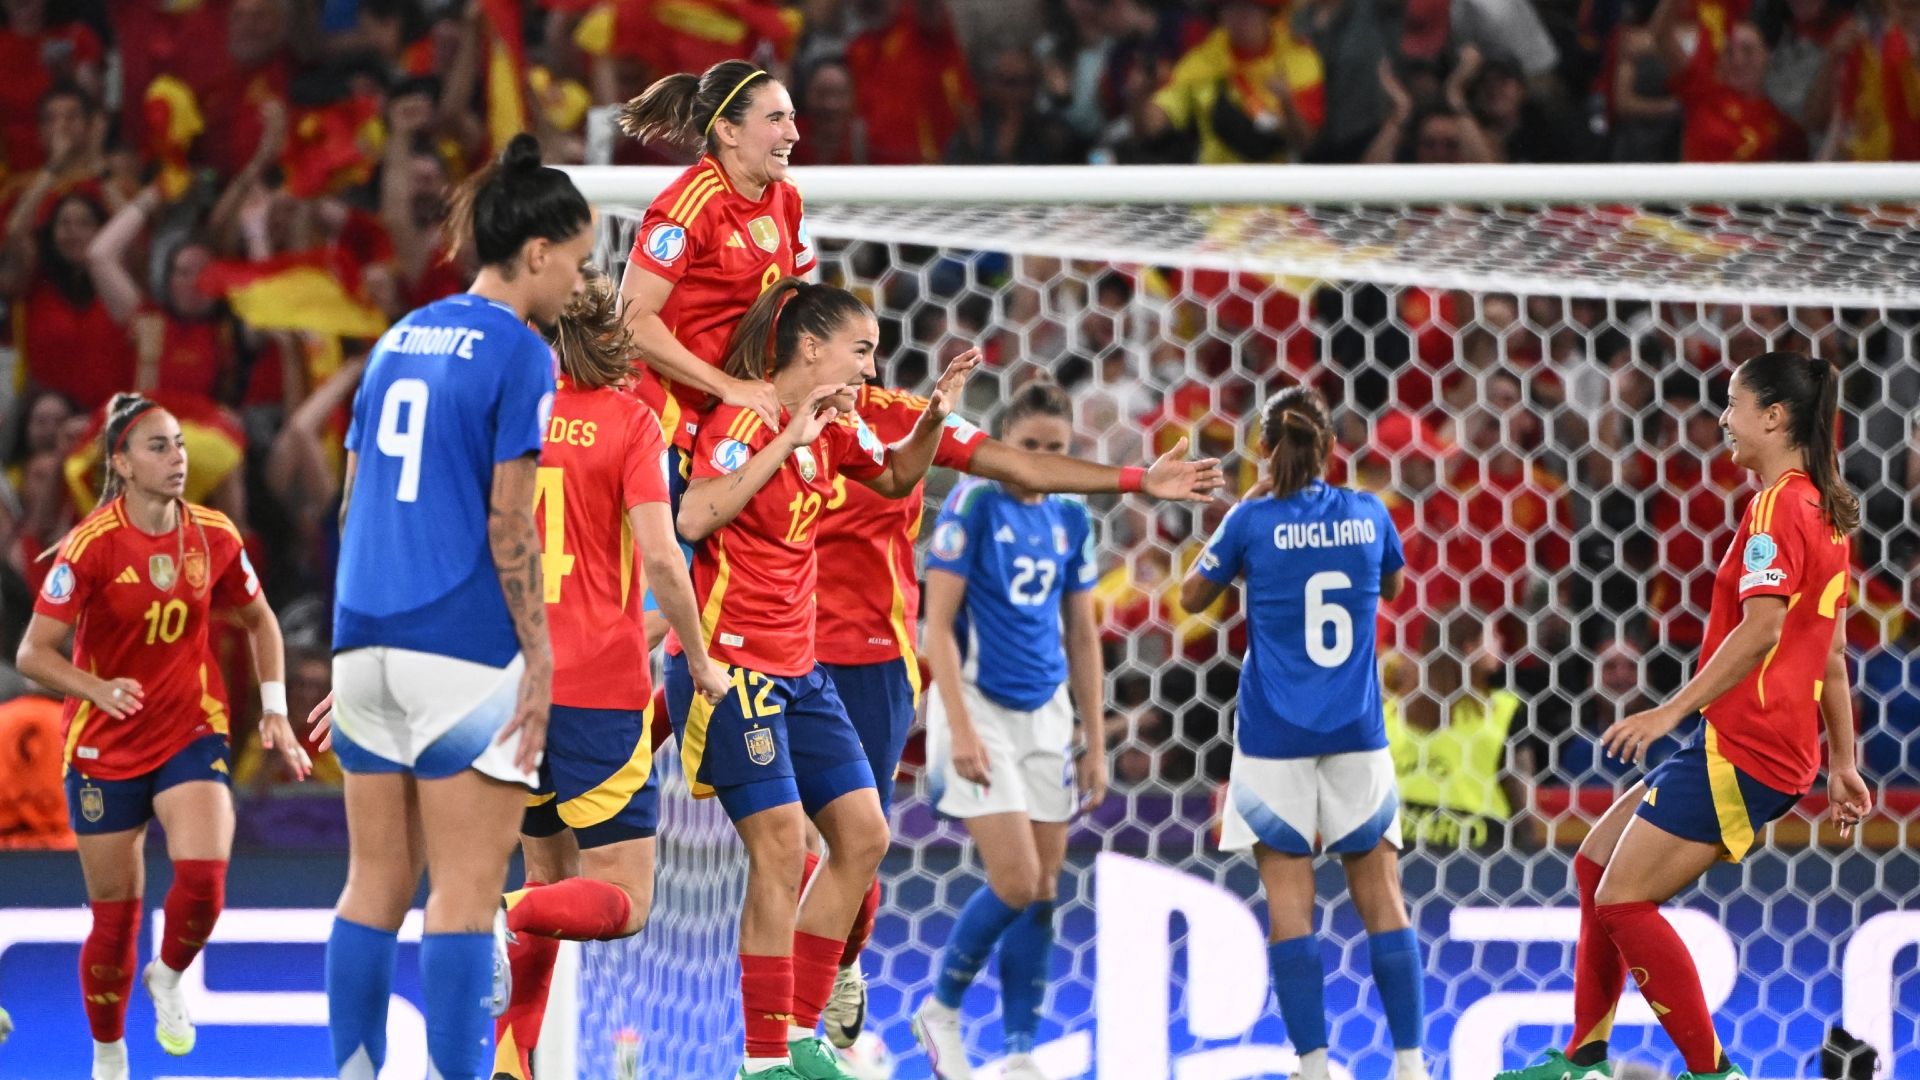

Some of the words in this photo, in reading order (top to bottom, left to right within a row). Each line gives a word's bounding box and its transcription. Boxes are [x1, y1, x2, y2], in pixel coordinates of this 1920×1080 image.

[384, 324, 485, 360] EMONTE
[376, 377, 430, 503] 9
[785, 491, 821, 543] 12
[1273, 518, 1376, 550] GIUGLIANO
[1010, 555, 1056, 606] 23
[144, 598, 188, 645] 10
[1304, 570, 1354, 669] 6
[730, 667, 781, 719] 12
